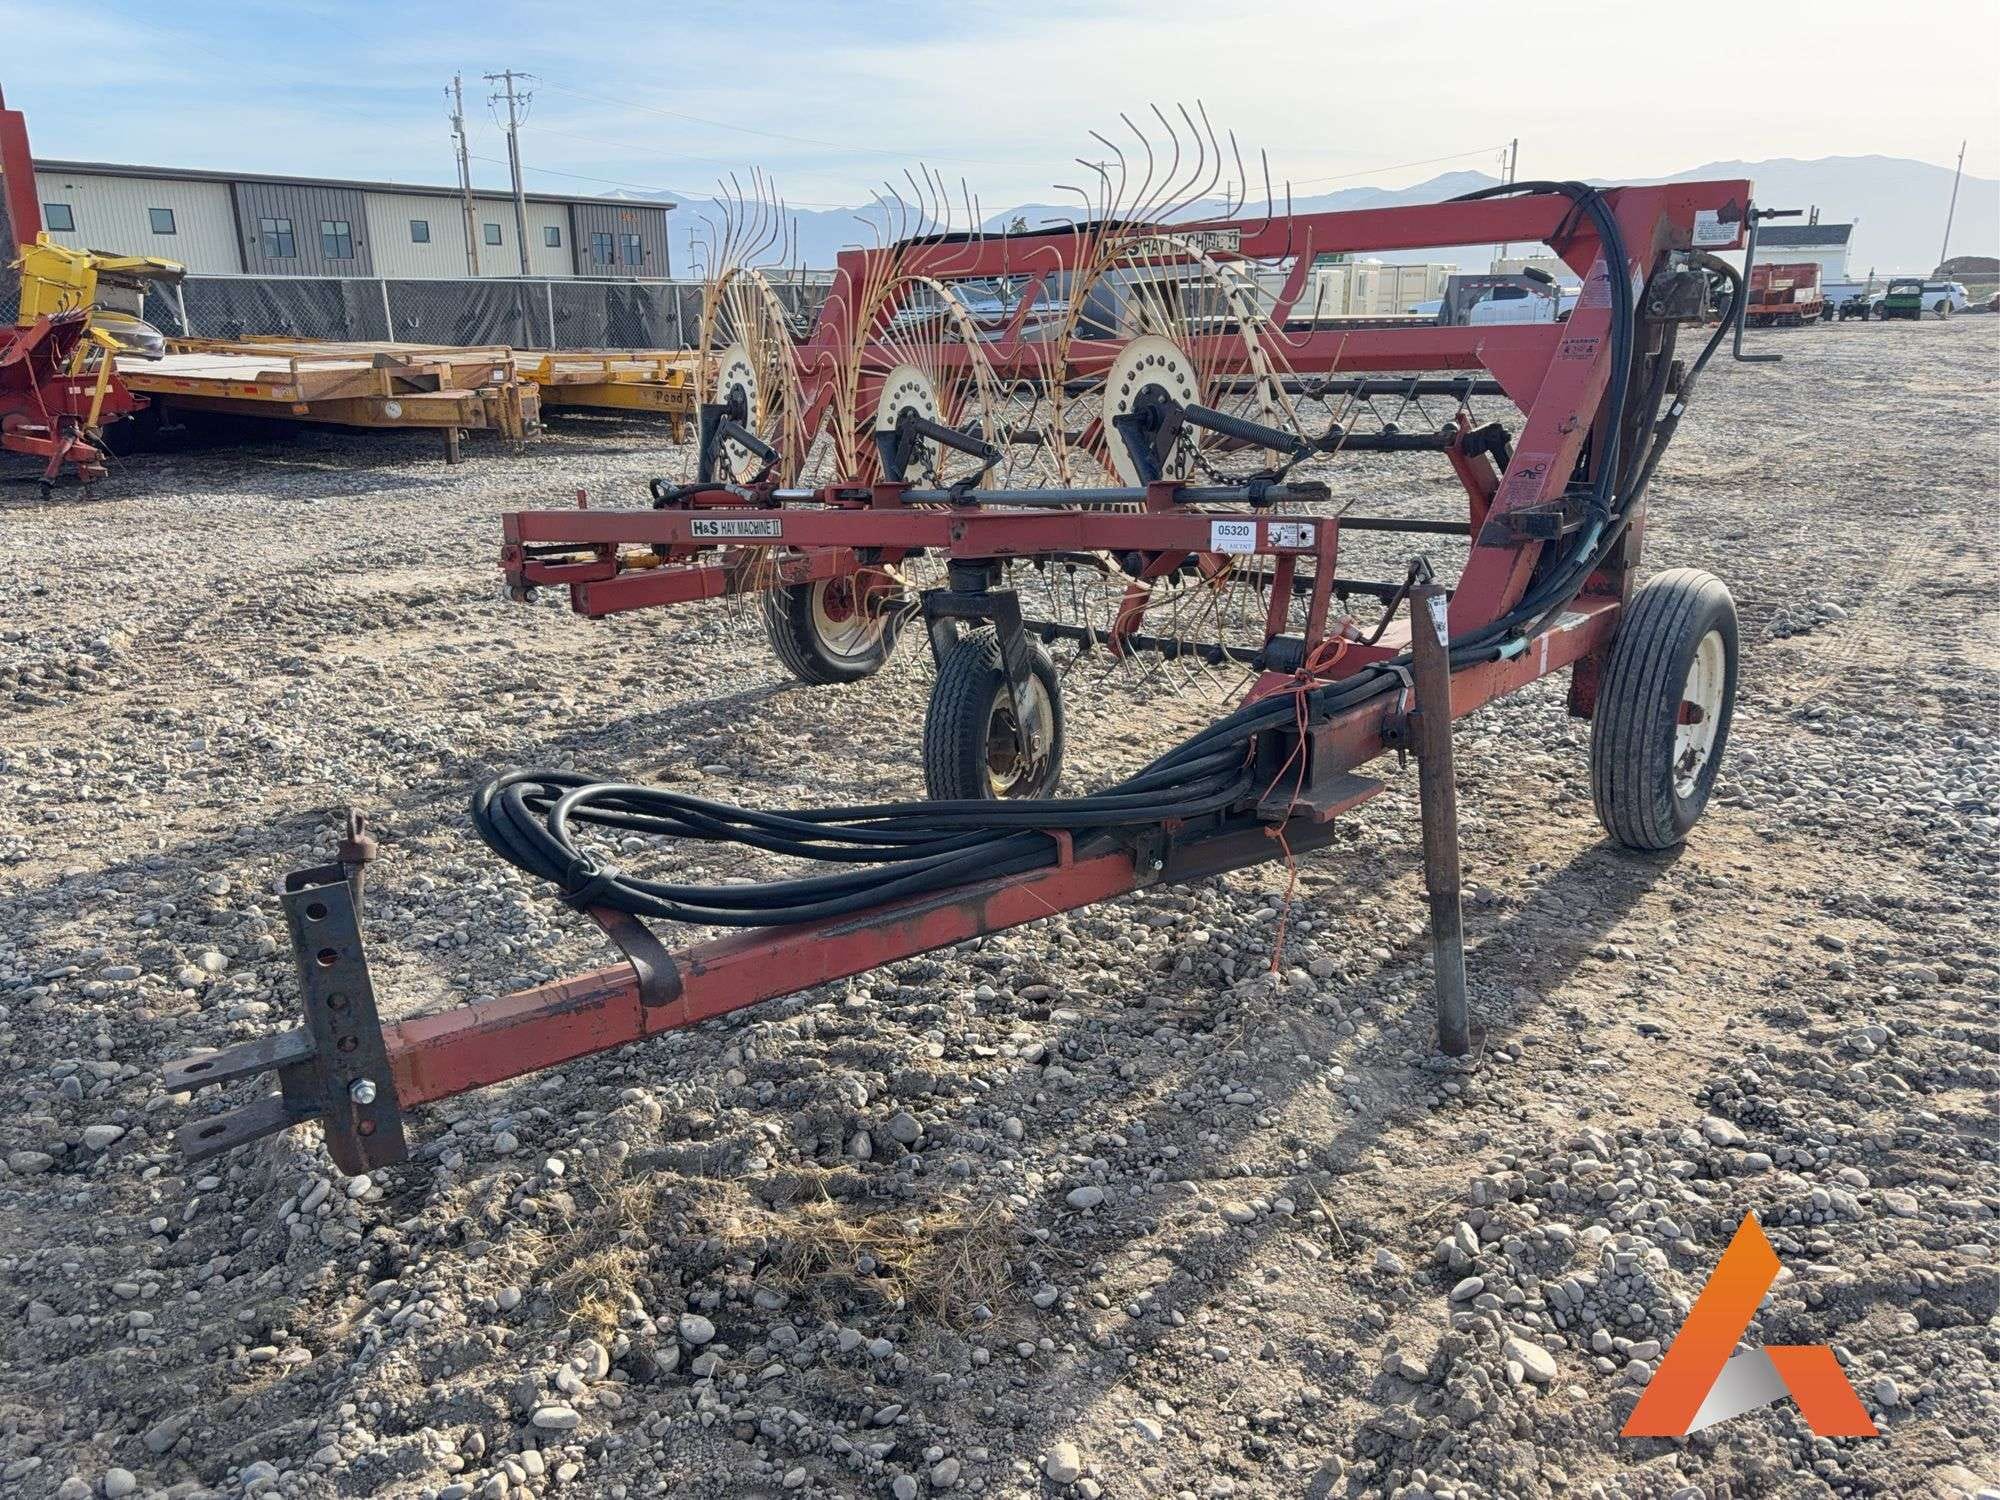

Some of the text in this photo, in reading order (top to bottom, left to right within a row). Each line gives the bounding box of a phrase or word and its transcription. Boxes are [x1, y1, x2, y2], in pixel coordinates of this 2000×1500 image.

[693, 521, 718, 535] H&S
[721, 521, 735, 535] HAY
[737, 520, 771, 535] MACHINE
[1218, 525, 1250, 536] 05320
